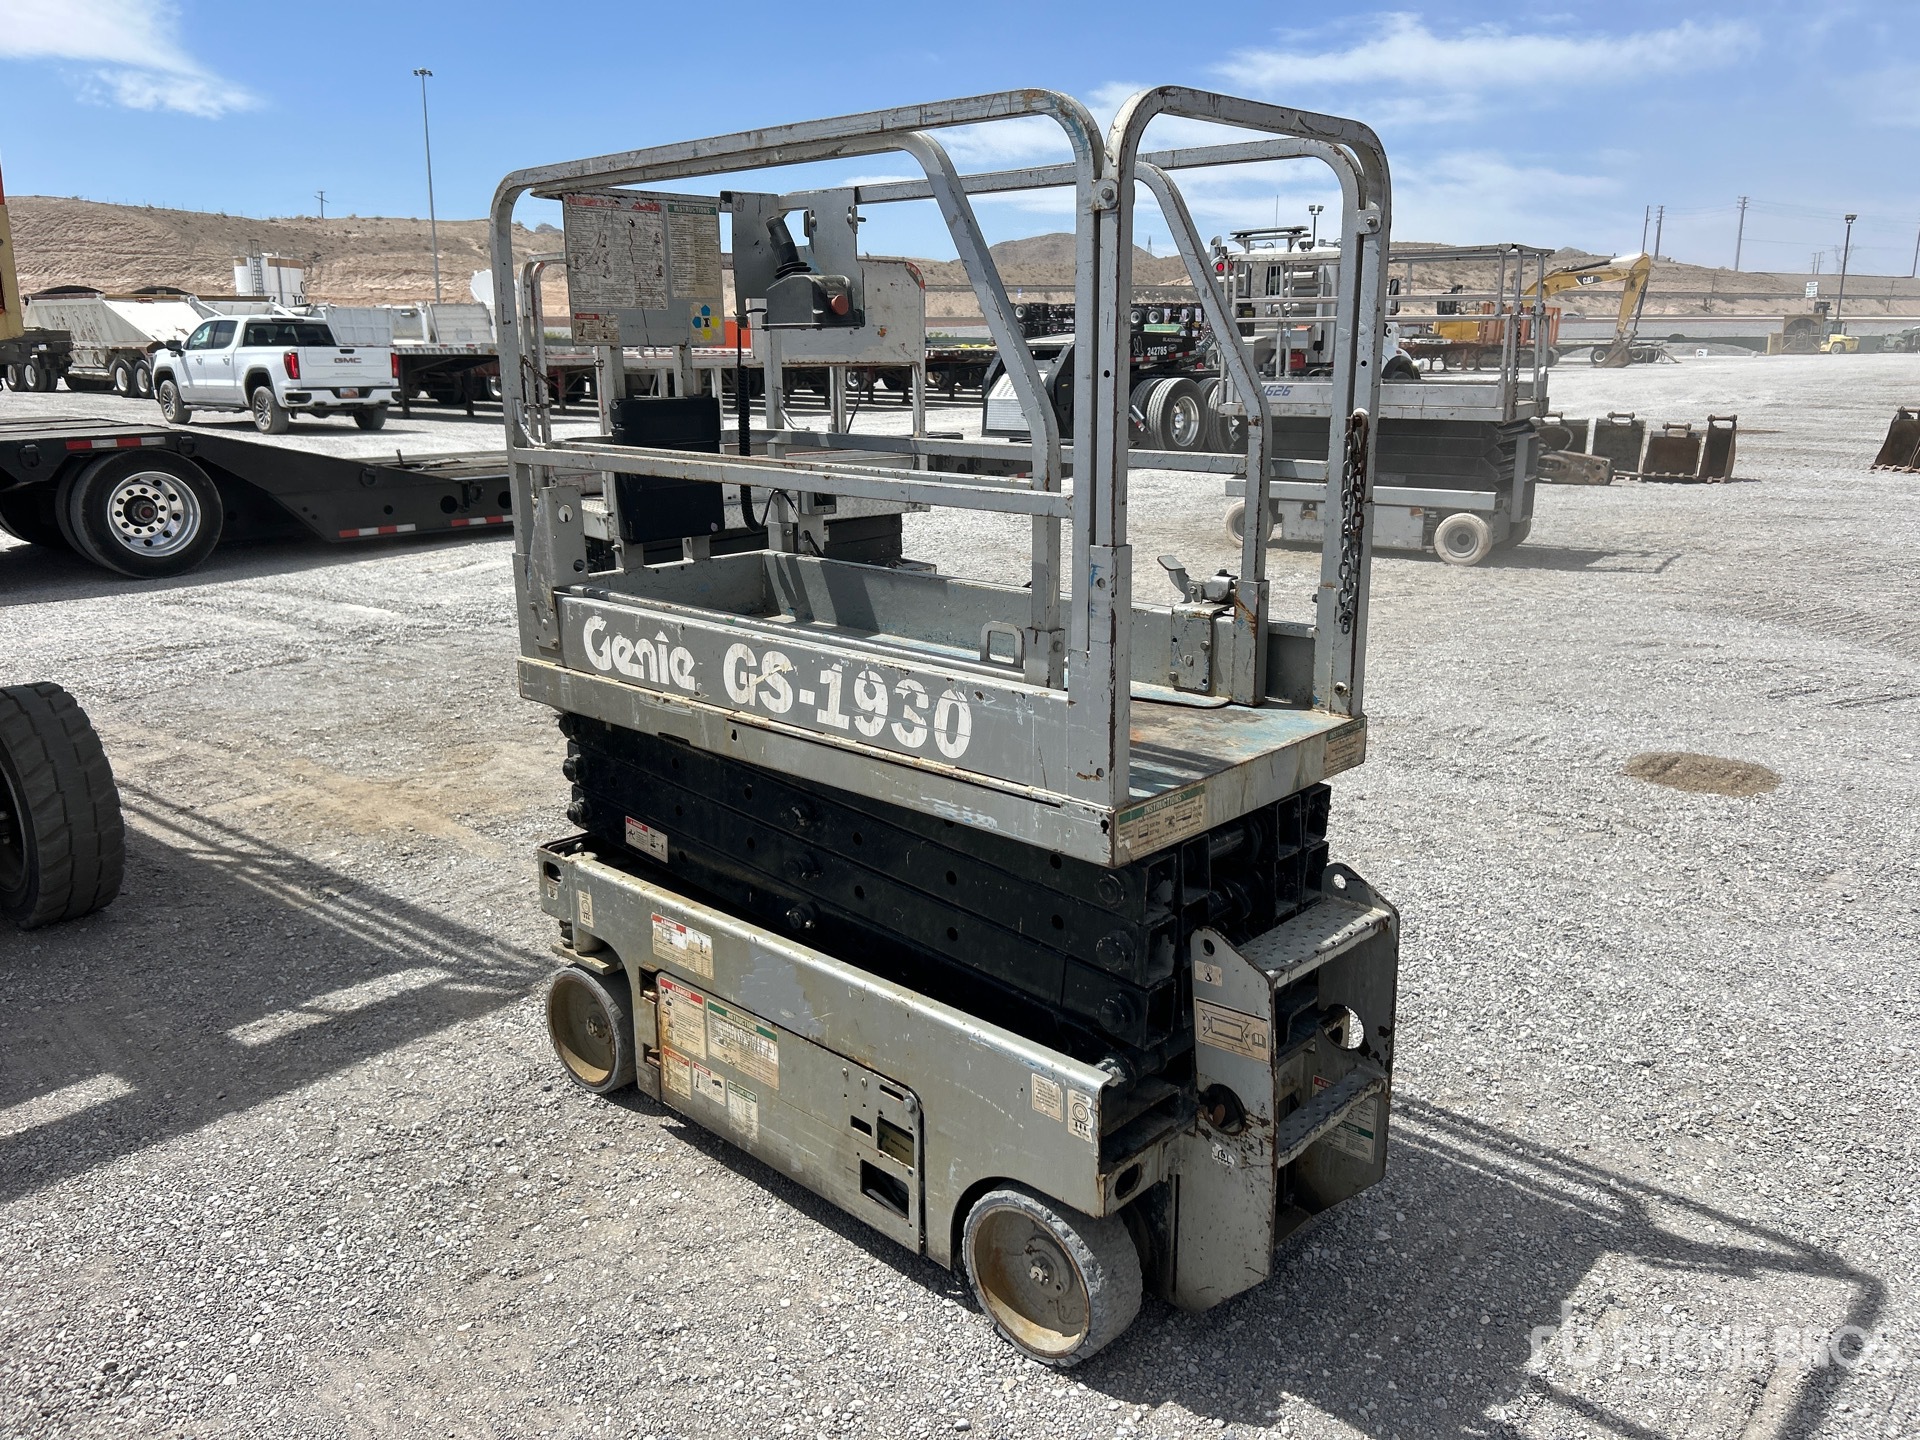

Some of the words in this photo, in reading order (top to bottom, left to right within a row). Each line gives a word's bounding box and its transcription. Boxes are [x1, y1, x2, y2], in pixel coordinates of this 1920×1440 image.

[1583, 275, 1595, 284] CAT
[1146, 346, 1168, 356] 242785
[1263, 385, 1294, 396] 626
[583, 615, 696, 690] Genie
[723, 642, 972, 759] GS-1930
[1143, 793, 1182, 814] INSTRUCTIONS
